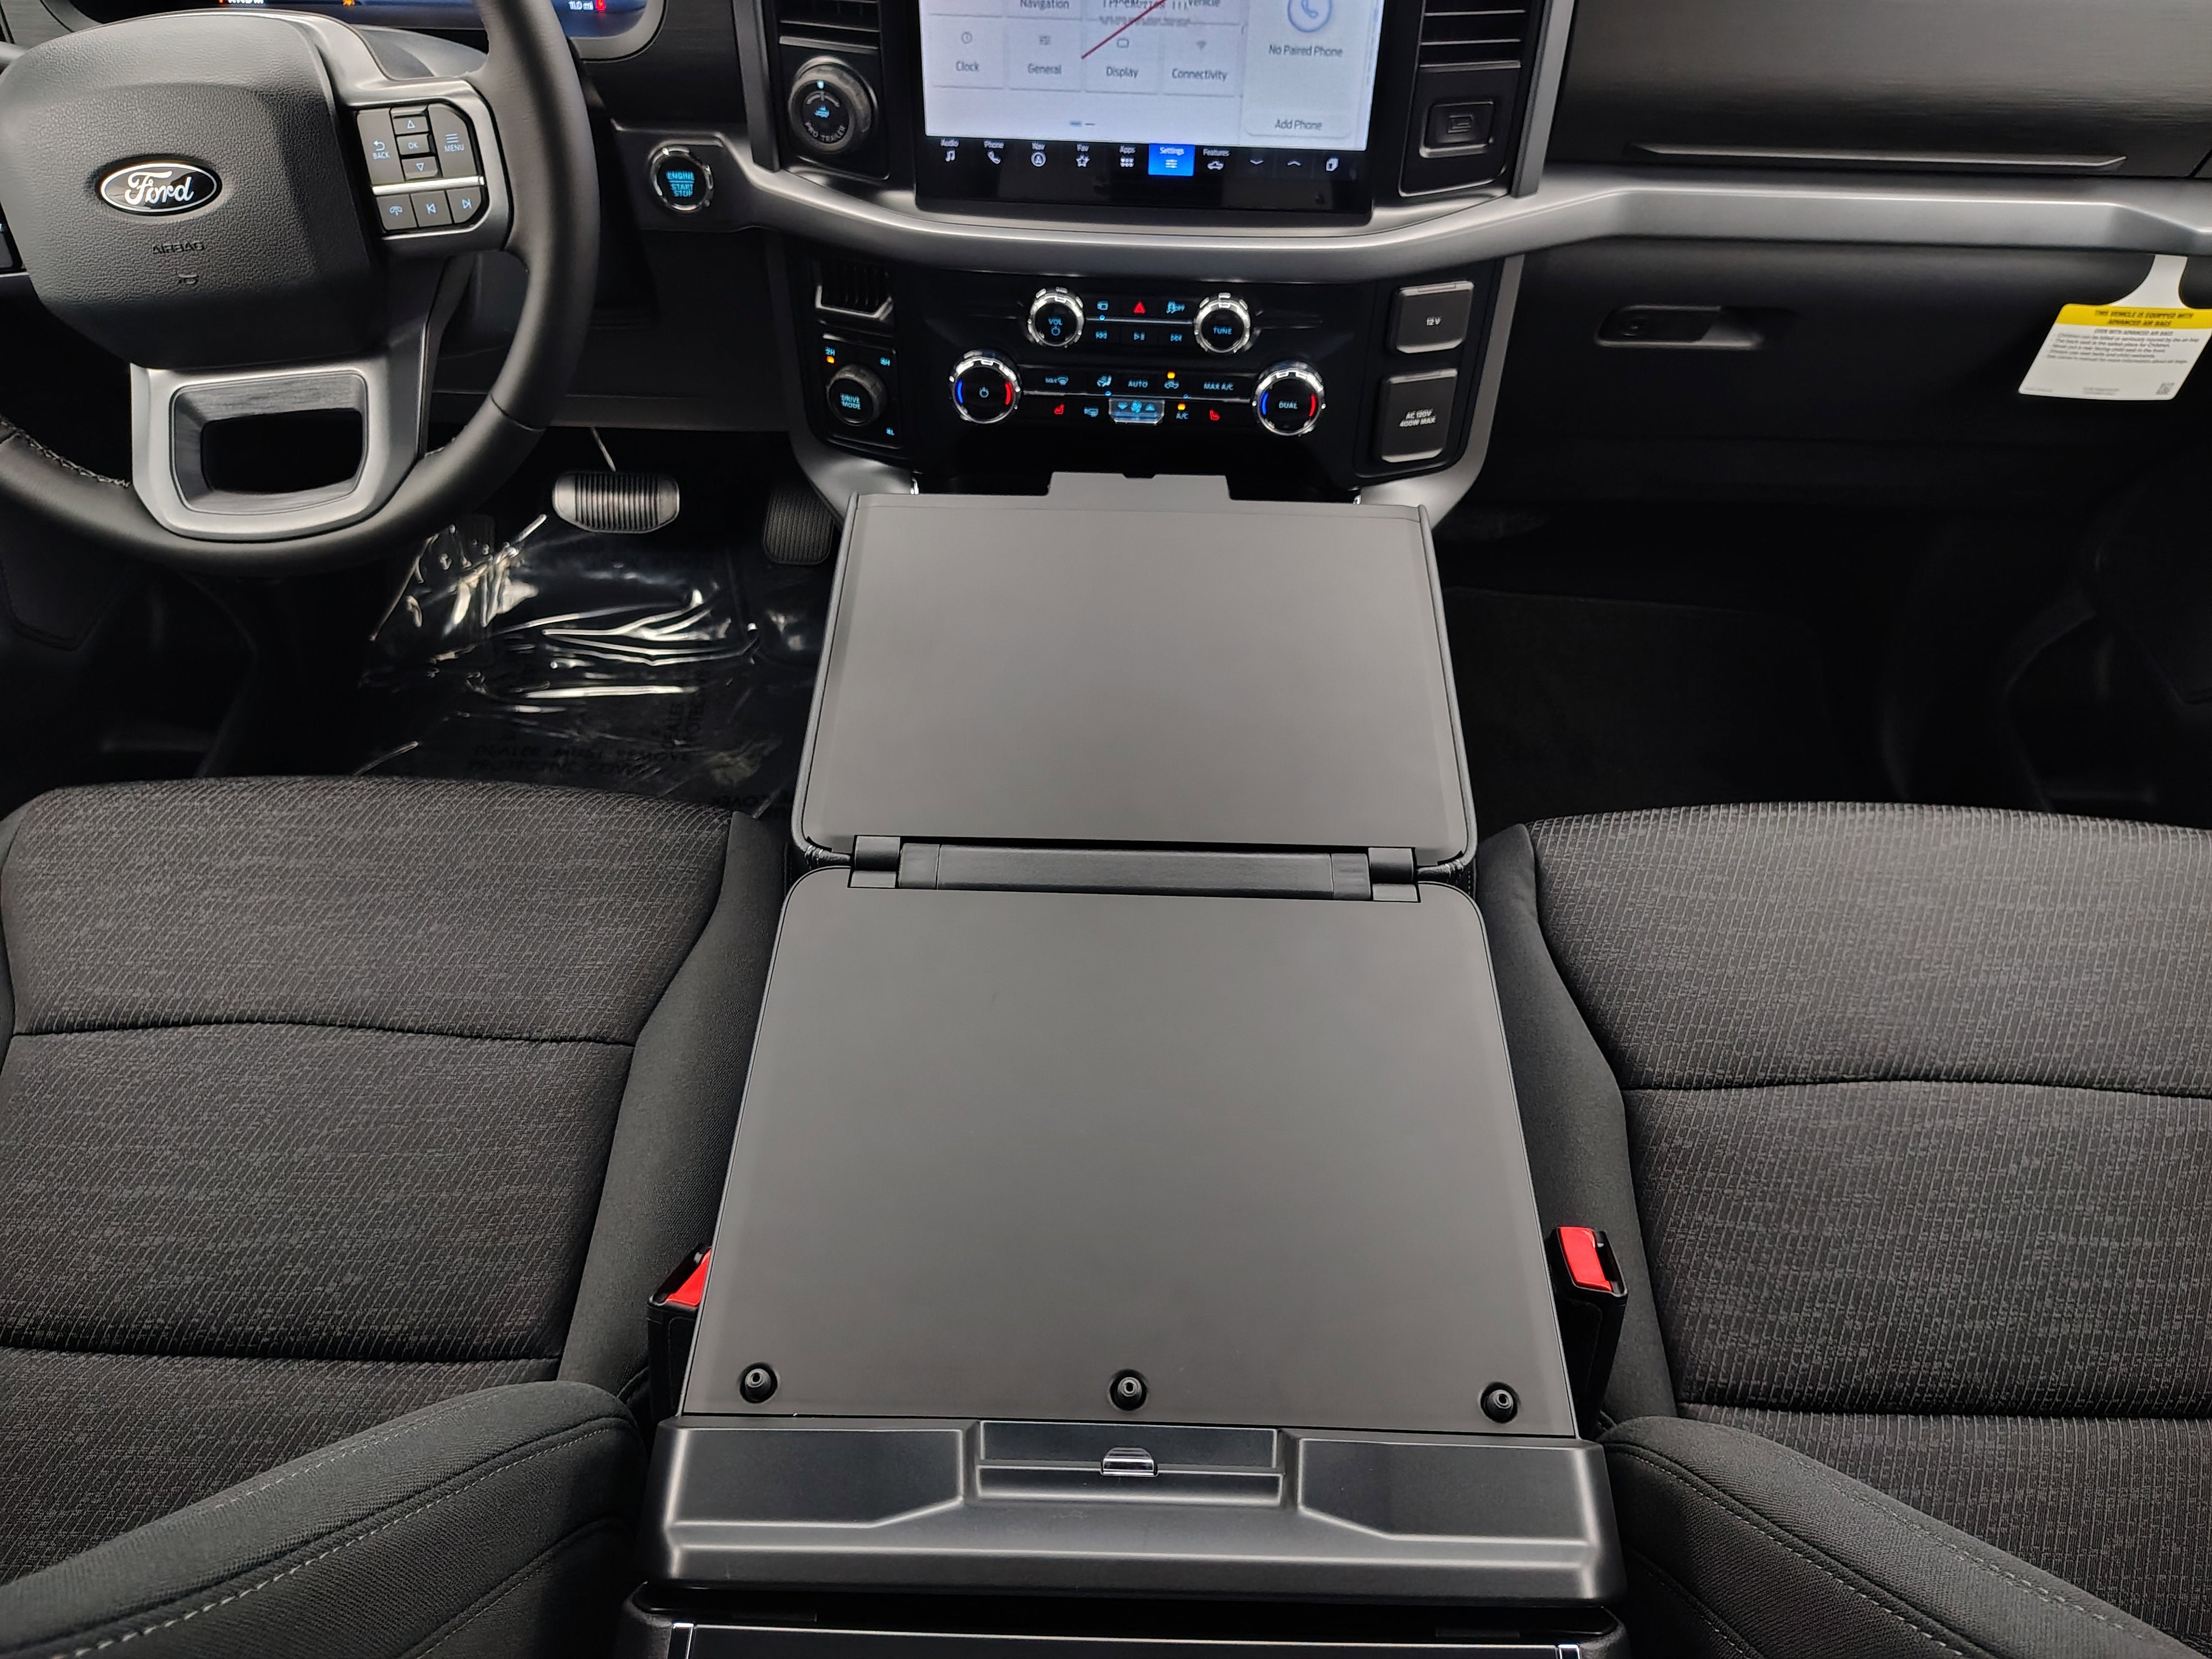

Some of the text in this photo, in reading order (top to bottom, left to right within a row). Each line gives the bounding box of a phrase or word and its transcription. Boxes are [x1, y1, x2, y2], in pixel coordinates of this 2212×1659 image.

[1020, 0, 1070, 10] Navigation
[1269, 44, 1343, 57] No Paired Phone
[955, 61, 980, 72] Clock
[1027, 64, 1062, 76] General
[1105, 66, 1139, 79] Display
[1171, 68, 1228, 82] Connectivity
[1274, 119, 1323, 131] Add Phone
[408, 141, 419, 150] OK
[444, 144, 465, 153] MENU
[373, 151, 390, 160] BACK
[1159, 146, 1185, 156] Settings
[1202, 148, 1231, 157] Features
[666, 171, 695, 180] ENGINE
[124, 171, 194, 206] Ford
[670, 183, 693, 191] START
[673, 190, 693, 198] STOP
[152, 241, 205, 255] AIRBAG
[1048, 317, 1063, 326] VOL
[1426, 316, 1442, 326] 12V
[1213, 326, 1233, 335] TUNE
[825, 346, 836, 356] 2H
[879, 357, 891, 367] 4H
[1128, 379, 1149, 388] AUTO
[1203, 381, 1235, 391] MAX A/C
[840, 393, 861, 404] DRIVE
[841, 401, 861, 410] MODE
[1278, 400, 1299, 409] DUAL
